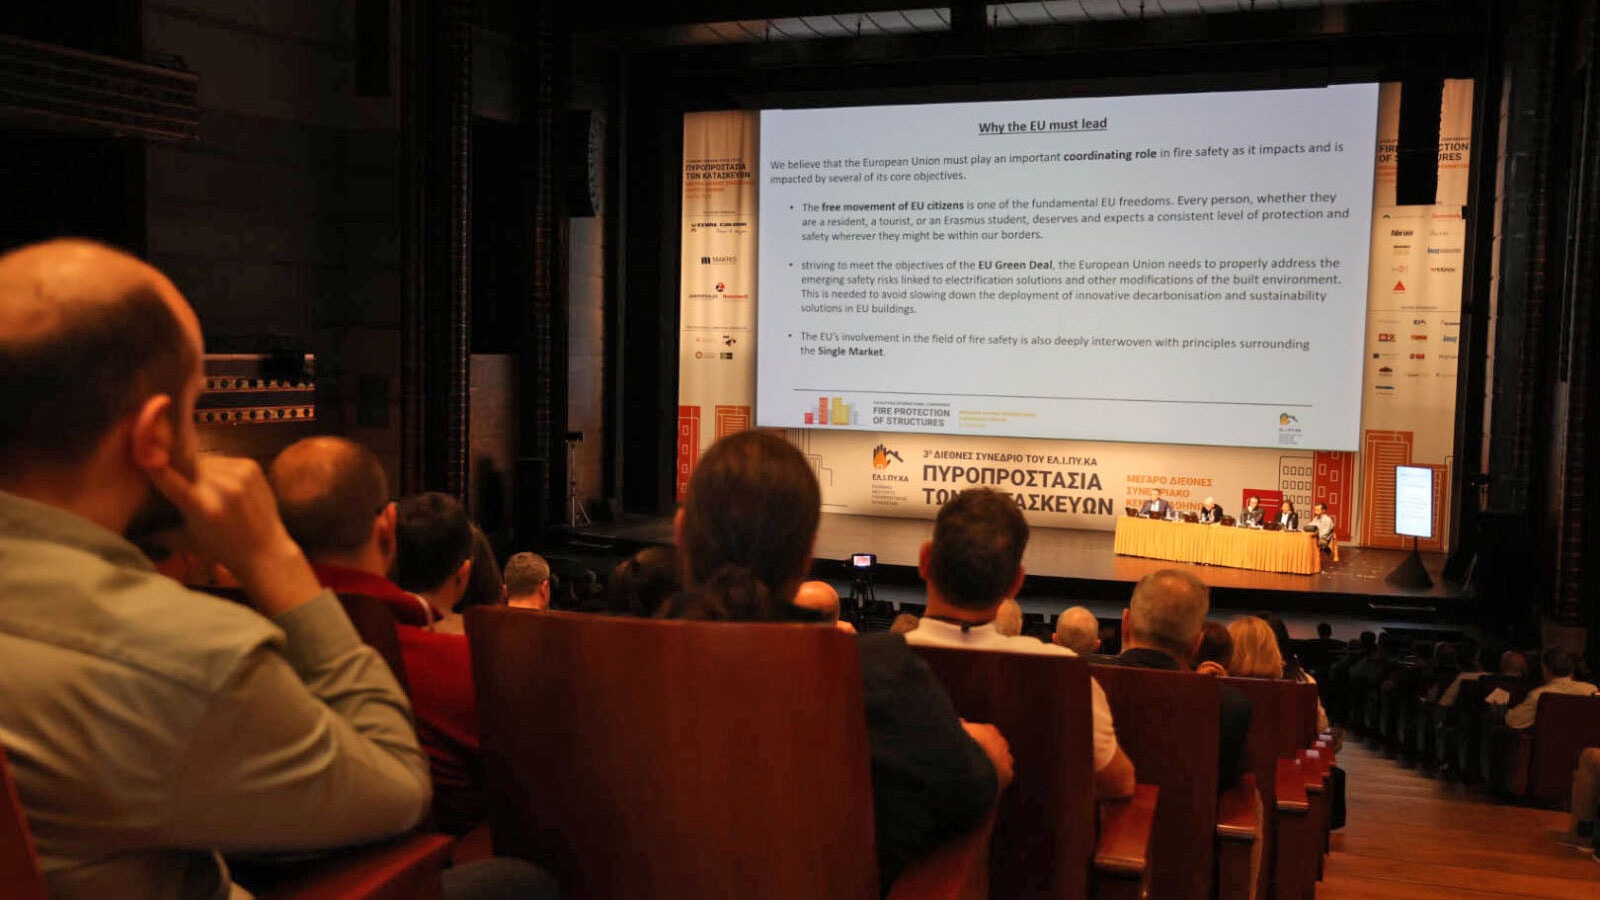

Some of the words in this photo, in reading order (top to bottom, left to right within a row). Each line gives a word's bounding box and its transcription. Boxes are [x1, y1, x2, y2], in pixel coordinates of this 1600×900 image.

[978, 121, 1005, 135] Why
[1007, 120, 1027, 134] the
[1030, 120, 1046, 133] EU
[1049, 119, 1079, 133] must
[1081, 116, 1107, 132] lead
[770, 161, 786, 170] We
[787, 159, 820, 169] believe
[822, 159, 842, 168] that
[844, 158, 861, 167] the
[862, 158, 909, 169] European
[911, 156, 940, 166] Union
[943, 155, 969, 165] must
[970, 153, 992, 166] play
[994, 155, 1007, 163] an
[1008, 152, 1062, 165] important
[1062, 149, 1133, 162] coordinating
[1134, 148, 1157, 159] role
[1159, 149, 1170, 158] in
[1172, 146, 1193, 158] fire
[1193, 145, 1230, 158] safety
[1231, 147, 1245, 156] as
[1247, 145, 1256, 155] it
[1258, 143, 1306, 156] impacts
[1308, 141, 1331, 153] and
[1334, 142, 1343, 152] is
[770, 173, 813, 186] impacted
[814, 174, 826, 184] by
[828, 172, 862, 182] several
[863, 172, 874, 182] of
[876, 172, 887, 182] its
[890, 173, 911, 181] core
[913, 170, 966, 182] objectives.
[802, 203, 820, 212] The
[821, 202, 841, 212] free
[842, 202, 896, 212] movement
[897, 201, 909, 211] of
[910, 201, 925, 211] EU
[926, 200, 964, 211] citizens
[966, 200, 974, 210] is
[976, 201, 996, 210] one
[998, 198, 1009, 209] of
[1012, 199, 1029, 209] the
[1032, 197, 1098, 209] fundamental
[1101, 197, 1116, 207] EU
[1118, 196, 1174, 207] freedoms.
[1177, 195, 1208, 207] Every
[1210, 195, 1253, 207] person,
[1256, 192, 1307, 204] whether
[1309, 191, 1337, 204] they
[802, 219, 817, 227] are
[826, 216, 868, 228] resident,
[870, 218, 876, 226] a
[878, 217, 913, 226] tourist,
[928, 217, 941, 225] an
[943, 215, 986, 225] Erasmus
[987, 214, 1030, 226] student,
[1032, 214, 1078, 224] deserves
[1080, 212, 1101, 223] and
[1103, 213, 1145, 224] expects
[1147, 214, 1154, 222] a
[1156, 211, 1214, 222] consistent
[1217, 209, 1243, 221] level
[1246, 209, 1259, 220] of
[1262, 209, 1323, 222] protection
[1326, 208, 1349, 219] and
[801, 231, 830, 243] safety
[831, 231, 876, 241] wherever
[878, 230, 900, 242] they
[901, 231, 930, 242] might
[932, 230, 945, 240] be
[948, 229, 978, 240] within
[1000, 229, 1043, 239] borders.
[801, 260, 835, 272] striving
[837, 261, 847, 270] to
[849, 261, 874, 270] meet
[876, 260, 892, 270] the
[894, 260, 944, 272] objectives
[946, 259, 957, 270] of
[958, 260, 975, 270] the
[978, 260, 992, 270] EU
[994, 260, 1026, 270] Green
[1028, 259, 1055, 271] Deal,
[1058, 260, 1076, 269] the
[1078, 259, 1129, 271] European
[1132, 259, 1165, 269] Union
[1168, 258, 1201, 269] needs
[1204, 259, 1216, 269] to
[1218, 258, 1268, 270] properly
[1270, 257, 1316, 268] address
[1319, 257, 1340, 268] the
[801, 275, 845, 286] emerging
[846, 274, 876, 286] safety
[877, 274, 899, 285] risks
[900, 275, 930, 284] linked
[932, 276, 943, 285] to
[944, 275, 1013, 285] electrification
[1016, 275, 1062, 285] solutions
[1064, 275, 1085, 285] and
[1087, 275, 1117, 285] other
[1119, 274, 1193, 285] modifications
[1196, 274, 1208, 285] of
[1210, 274, 1230, 285] the
[1232, 274, 1259, 285] built
[1262, 275, 1341, 285] environment.
[802, 302, 843, 313] solutions
[855, 304, 869, 313] EU
[871, 303, 917, 316] buildings.
[800, 331, 817, 341] The
[841, 332, 900, 342] involvement
[902, 334, 911, 342] in
[913, 333, 929, 343] the
[932, 334, 954, 343] field
[955, 334, 967, 344] of
[968, 334, 986, 344] fire
[988, 335, 1018, 346] safety
[1020, 336, 1029, 344] is
[1030, 335, 1052, 345] also
[1054, 336, 1089, 347] deeply
[1092, 336, 1152, 347] interwoven
[1154, 337, 1179, 347] with
[1182, 338, 1236, 350] principles
[1239, 338, 1310, 352] surrounding
[800, 345, 816, 355] the
[817, 345, 846, 358] Single
[848, 346, 885, 356] Market.
[873, 406, 892, 415] FIRE
[894, 407, 950, 417] PROTECTION
[873, 416, 884, 425] OF
[886, 417, 945, 427] STRUCTURES
[934, 450, 973, 460] ΔΙΕΘΝΕΣ
[976, 452, 1023, 463] ΣΥΝΕΔΡΙΟ
[1025, 454, 1044, 464] ΤΟΥ
[923, 464, 1102, 491] ΠΥΡΟΠΡΟΣΤΑΣΙΑ
[1126, 475, 1167, 484] ΜΕΓΑΡΟ
[1169, 476, 1213, 487] ΔΙΕΘΝΕΣ
[1126, 486, 1190, 498] ΣΥΝΕΡΙΑΚΟ
[1004, 493, 1114, 515] ΑΣΚΕΥΩΝ
